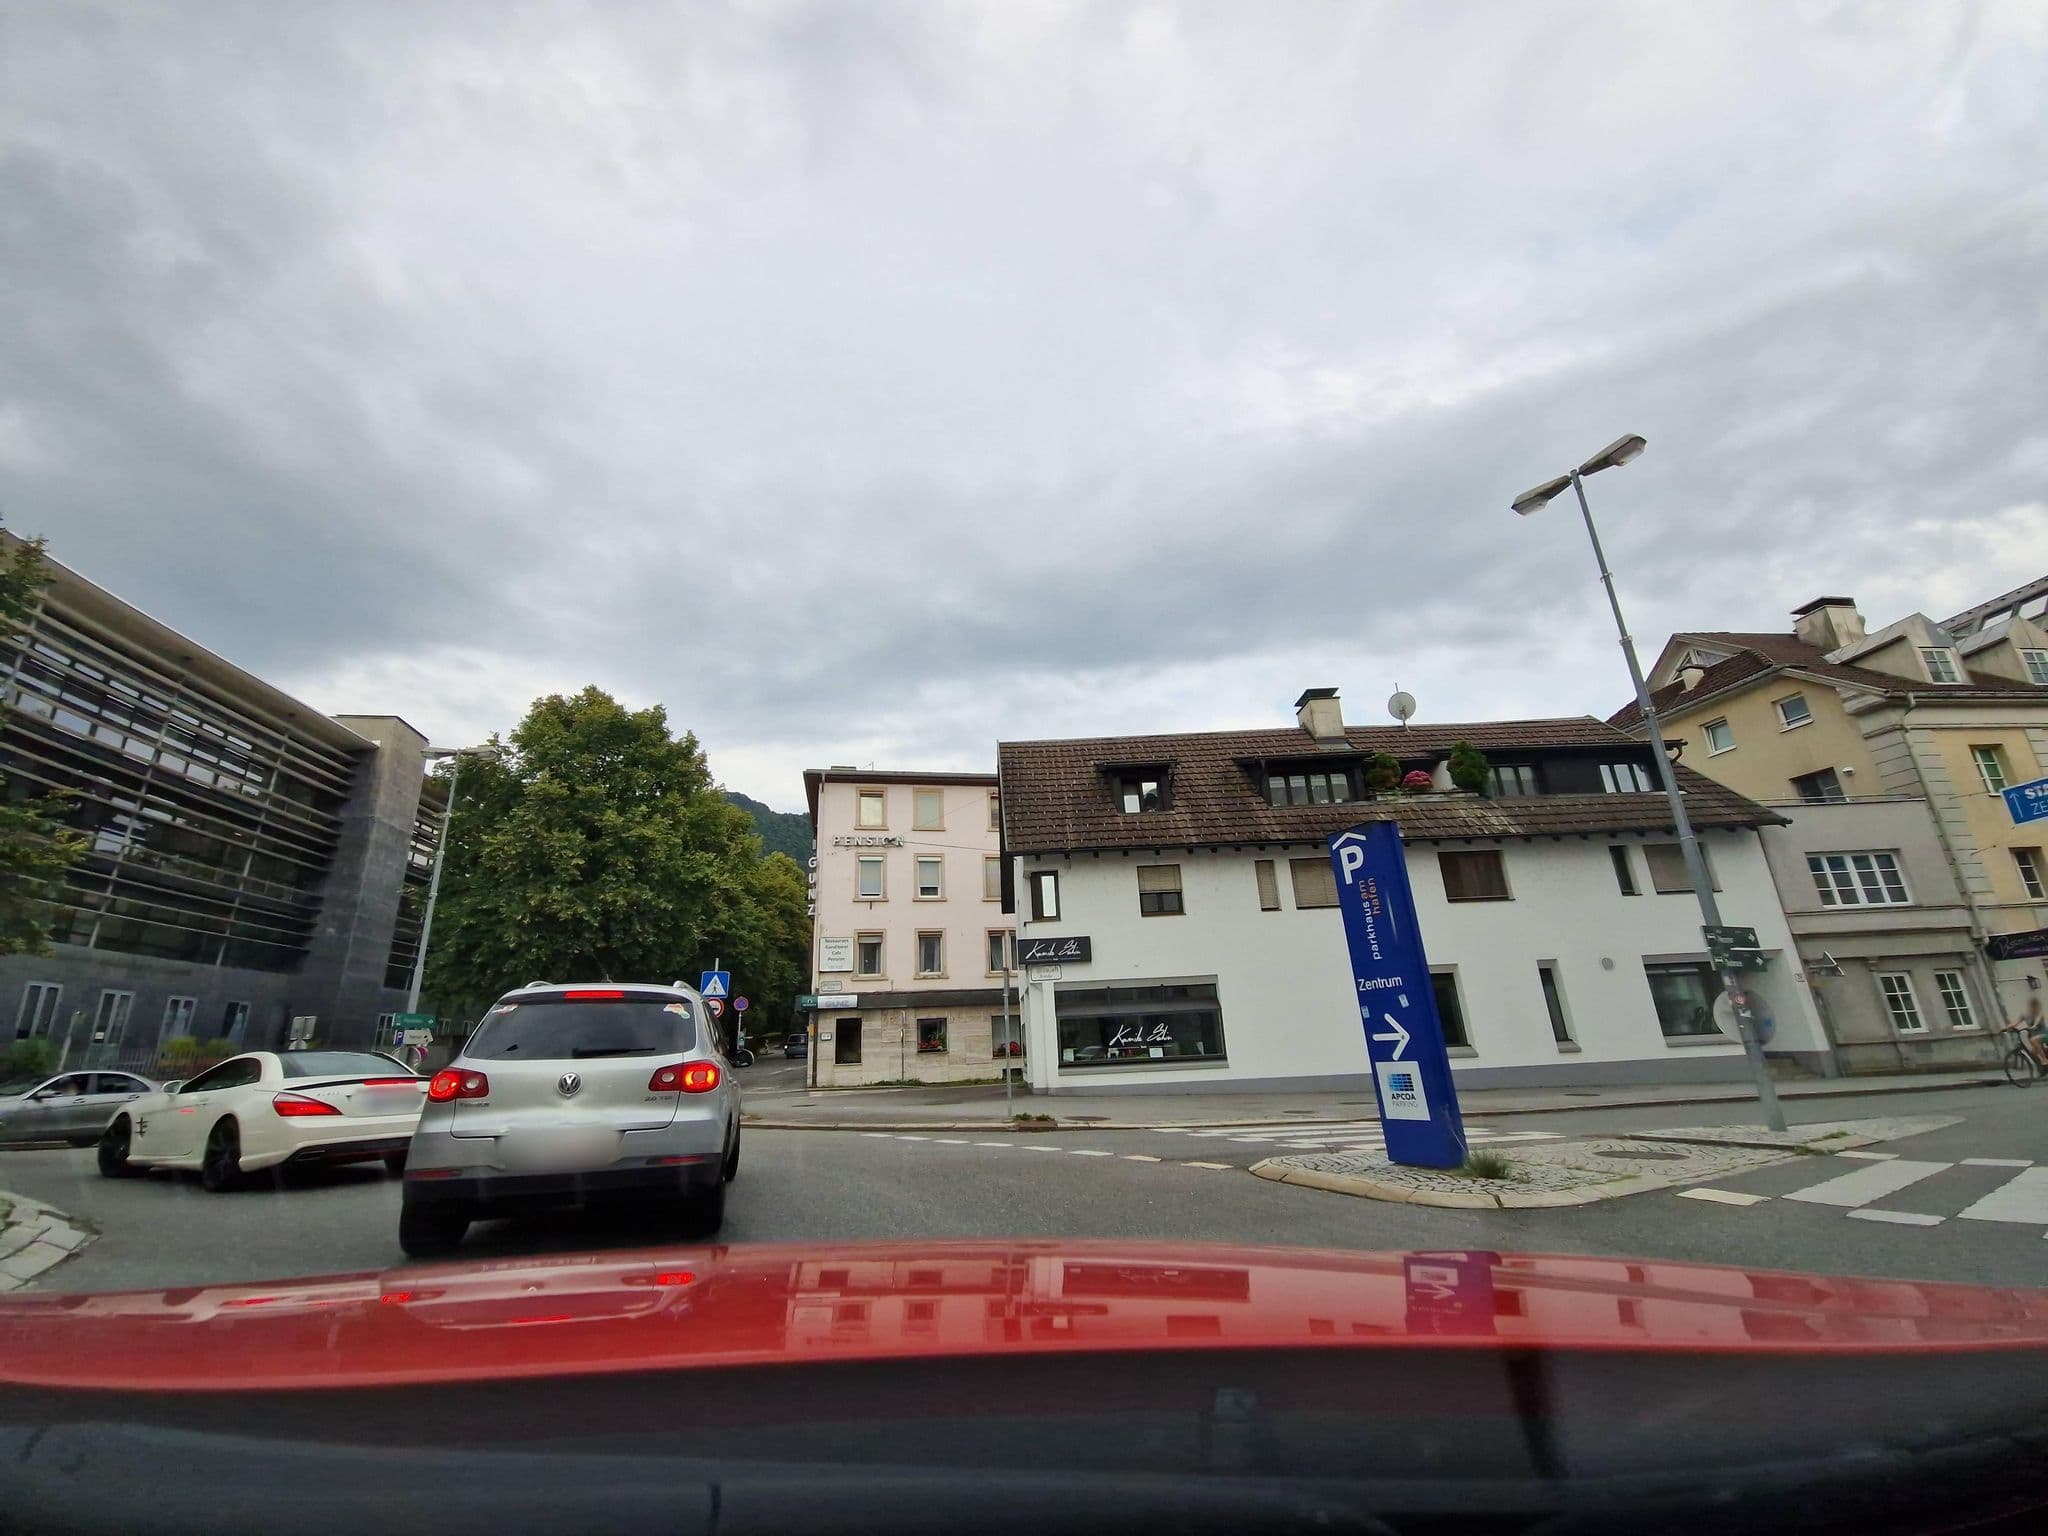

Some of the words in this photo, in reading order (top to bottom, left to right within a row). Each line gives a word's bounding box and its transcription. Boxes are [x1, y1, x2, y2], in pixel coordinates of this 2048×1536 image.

[2030, 800, 2048, 815] ZE
[833, 835, 904, 848] PENSION
[1340, 845, 1364, 885] P
[1359, 880, 1369, 899] am
[1368, 877, 1381, 915] hafen
[1363, 901, 1382, 960] parkhaus
[1358, 976, 1403, 991] Zentrum
[1392, 1093, 1416, 1101] APCOA
